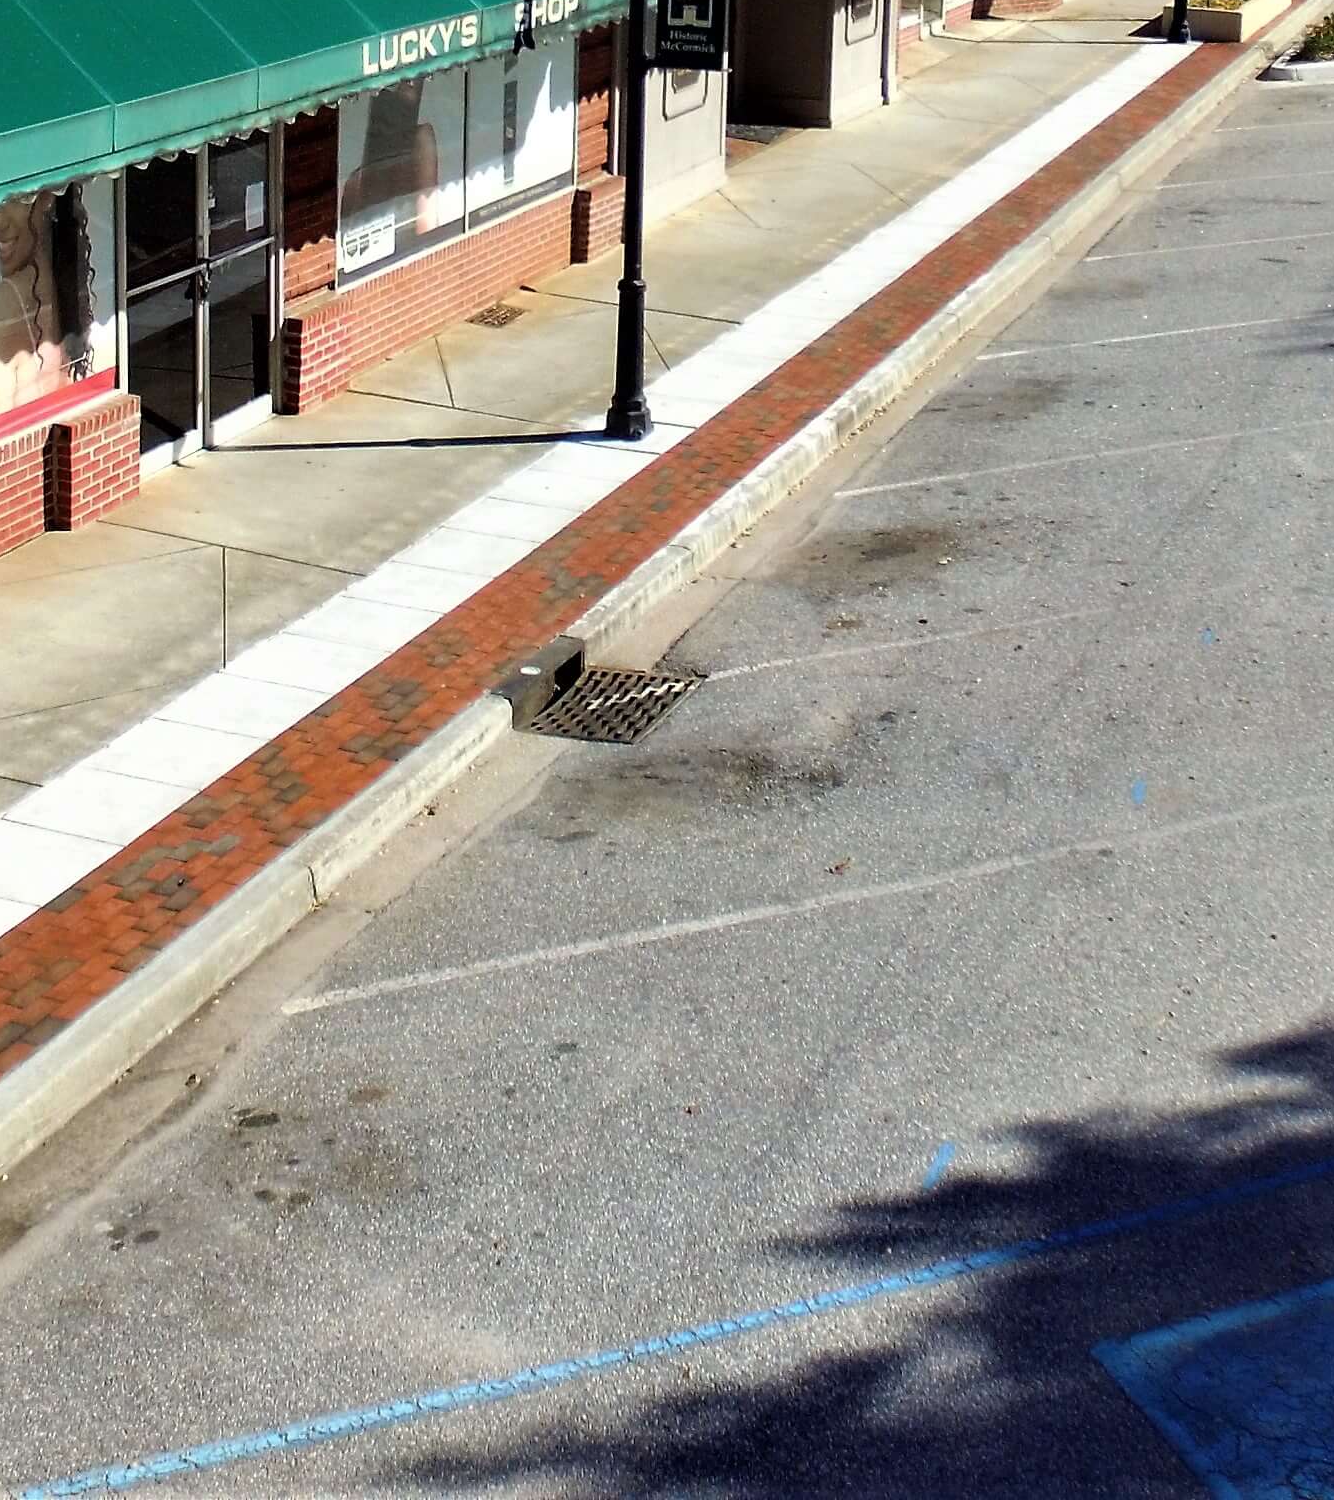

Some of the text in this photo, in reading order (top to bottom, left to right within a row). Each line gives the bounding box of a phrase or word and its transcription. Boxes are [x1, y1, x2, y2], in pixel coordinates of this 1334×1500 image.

[669, 30, 708, 42] Historic
[362, 14, 478, 75] LUCKY'S
[660, 40, 716, 54] McCormick
